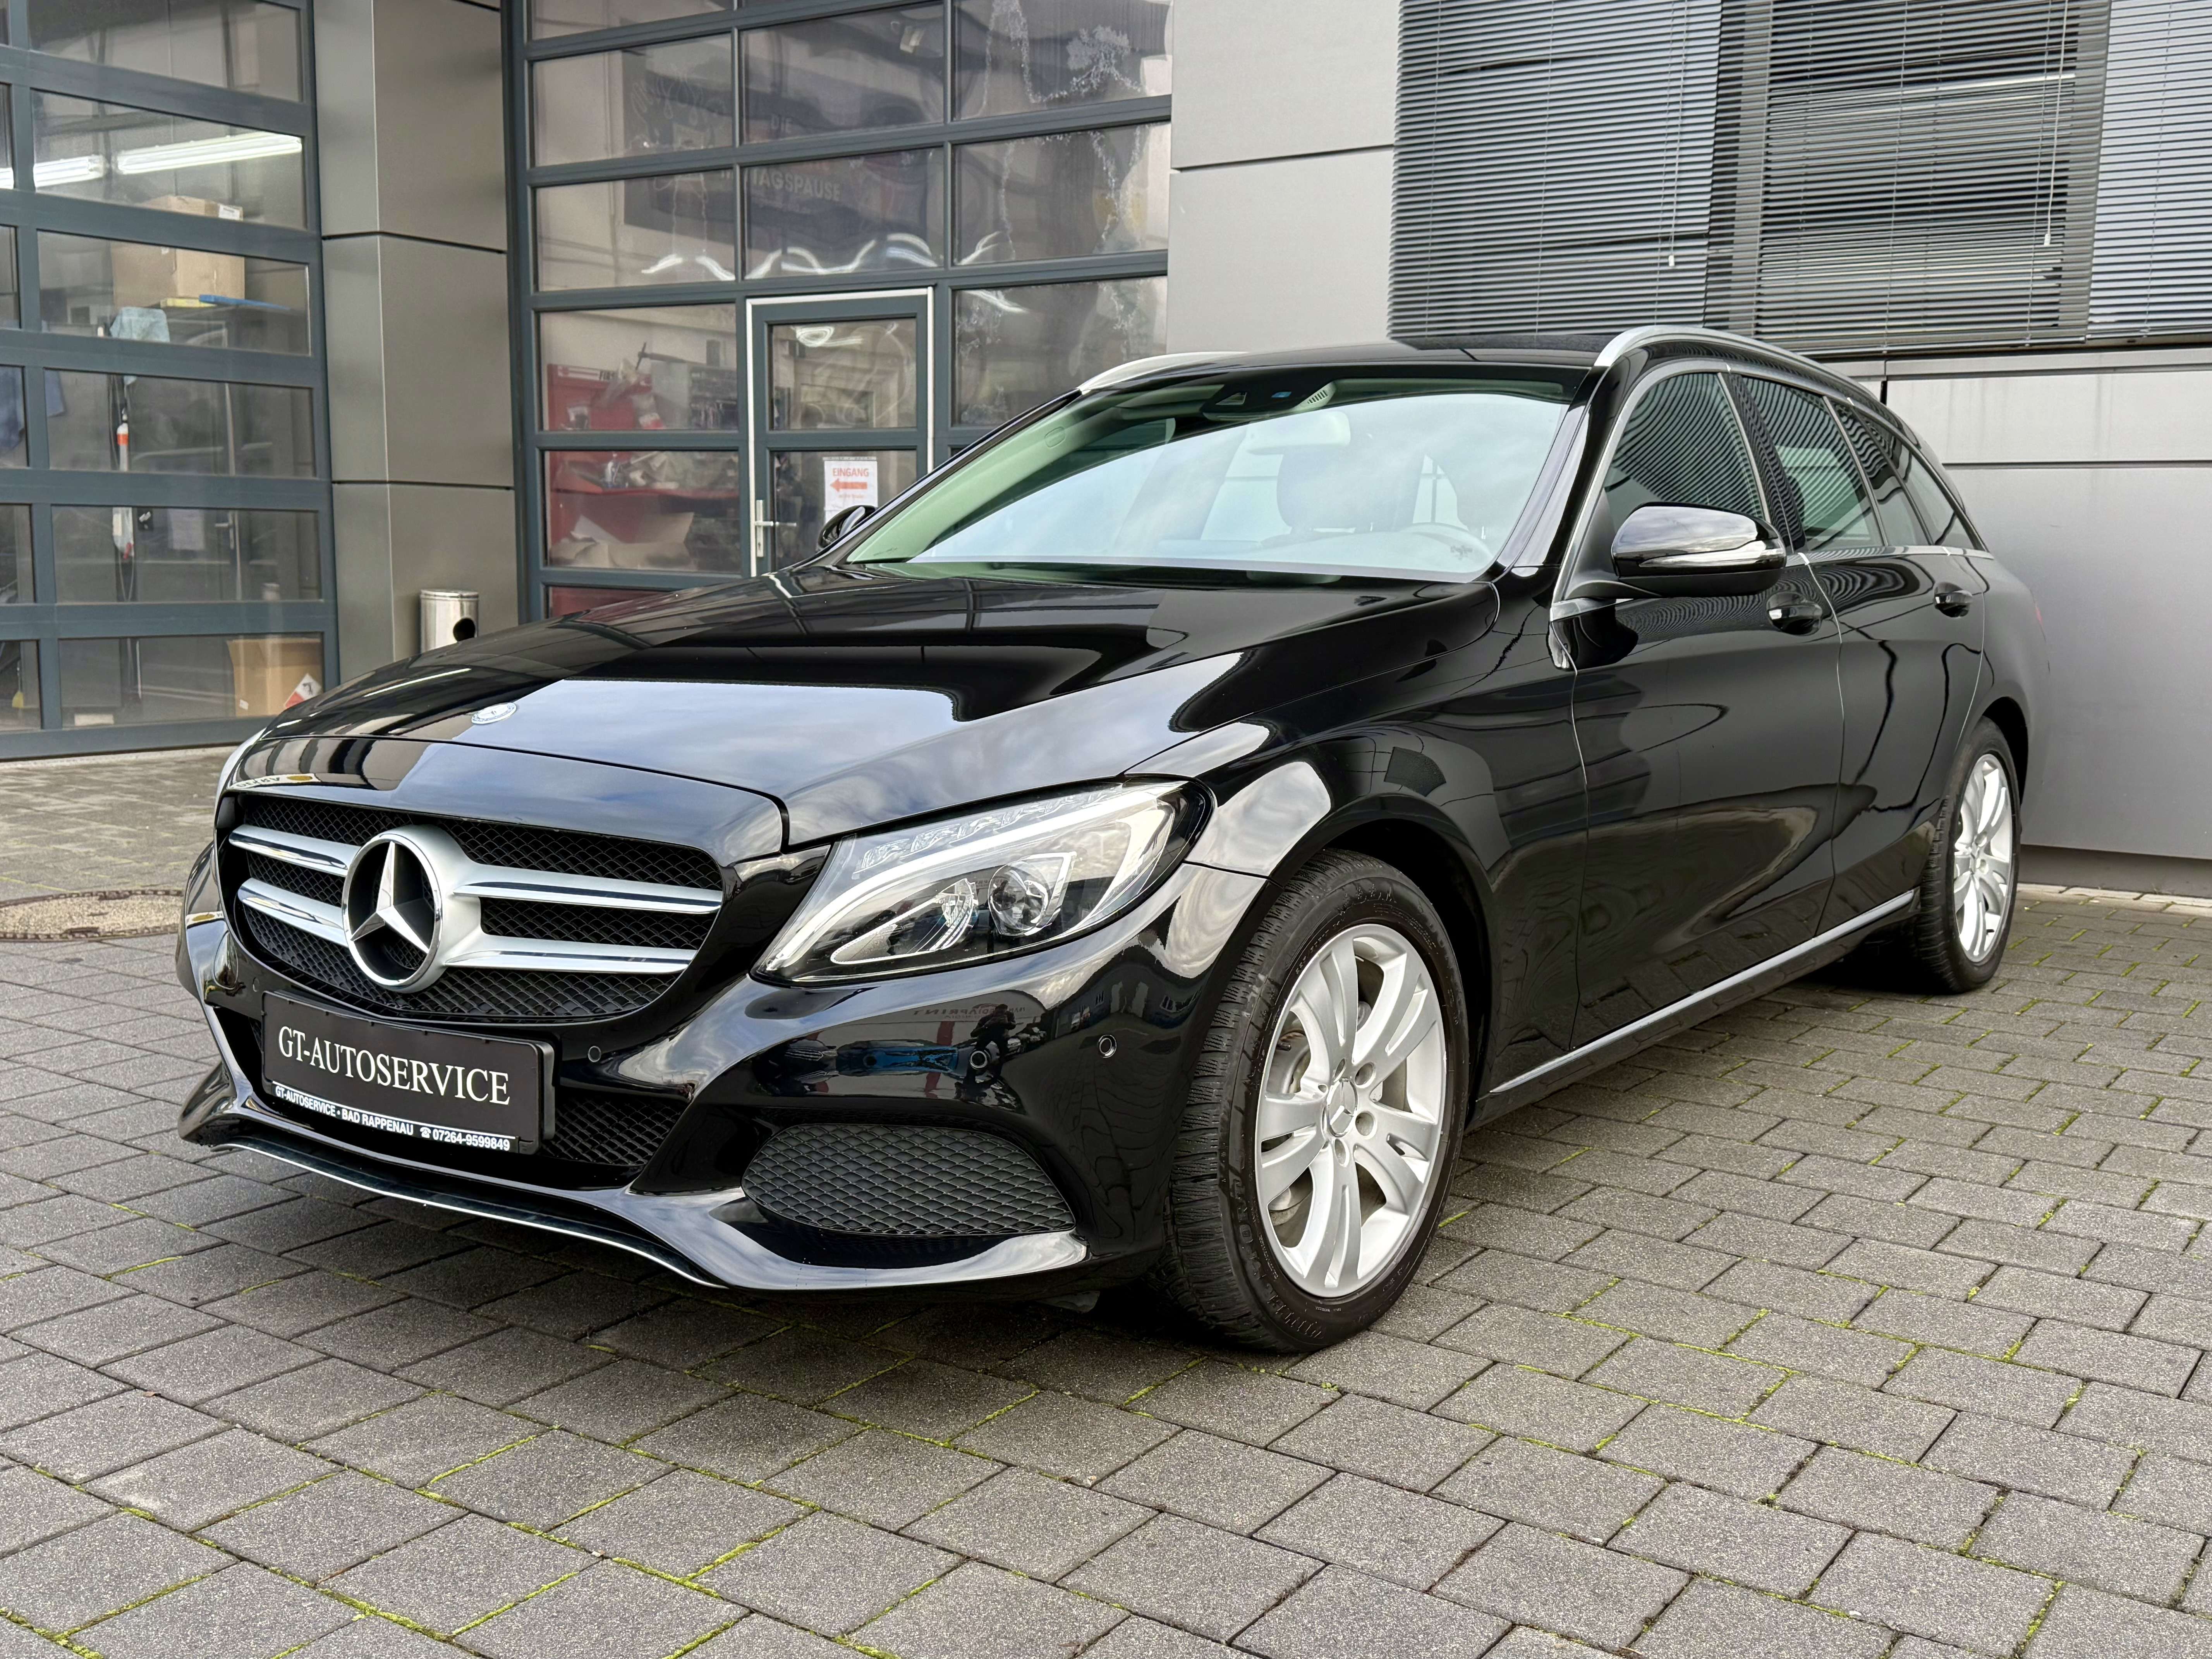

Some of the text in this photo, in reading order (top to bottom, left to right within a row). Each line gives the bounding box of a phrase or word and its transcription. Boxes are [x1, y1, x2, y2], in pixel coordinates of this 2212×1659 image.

[832, 467, 870, 477] EINGANG
[278, 1026, 510, 1105] GT-AUTOSERVICE
[275, 1085, 510, 1151] GT-AUTOSERVICE BAD RAPPENAU 07264-9599849
